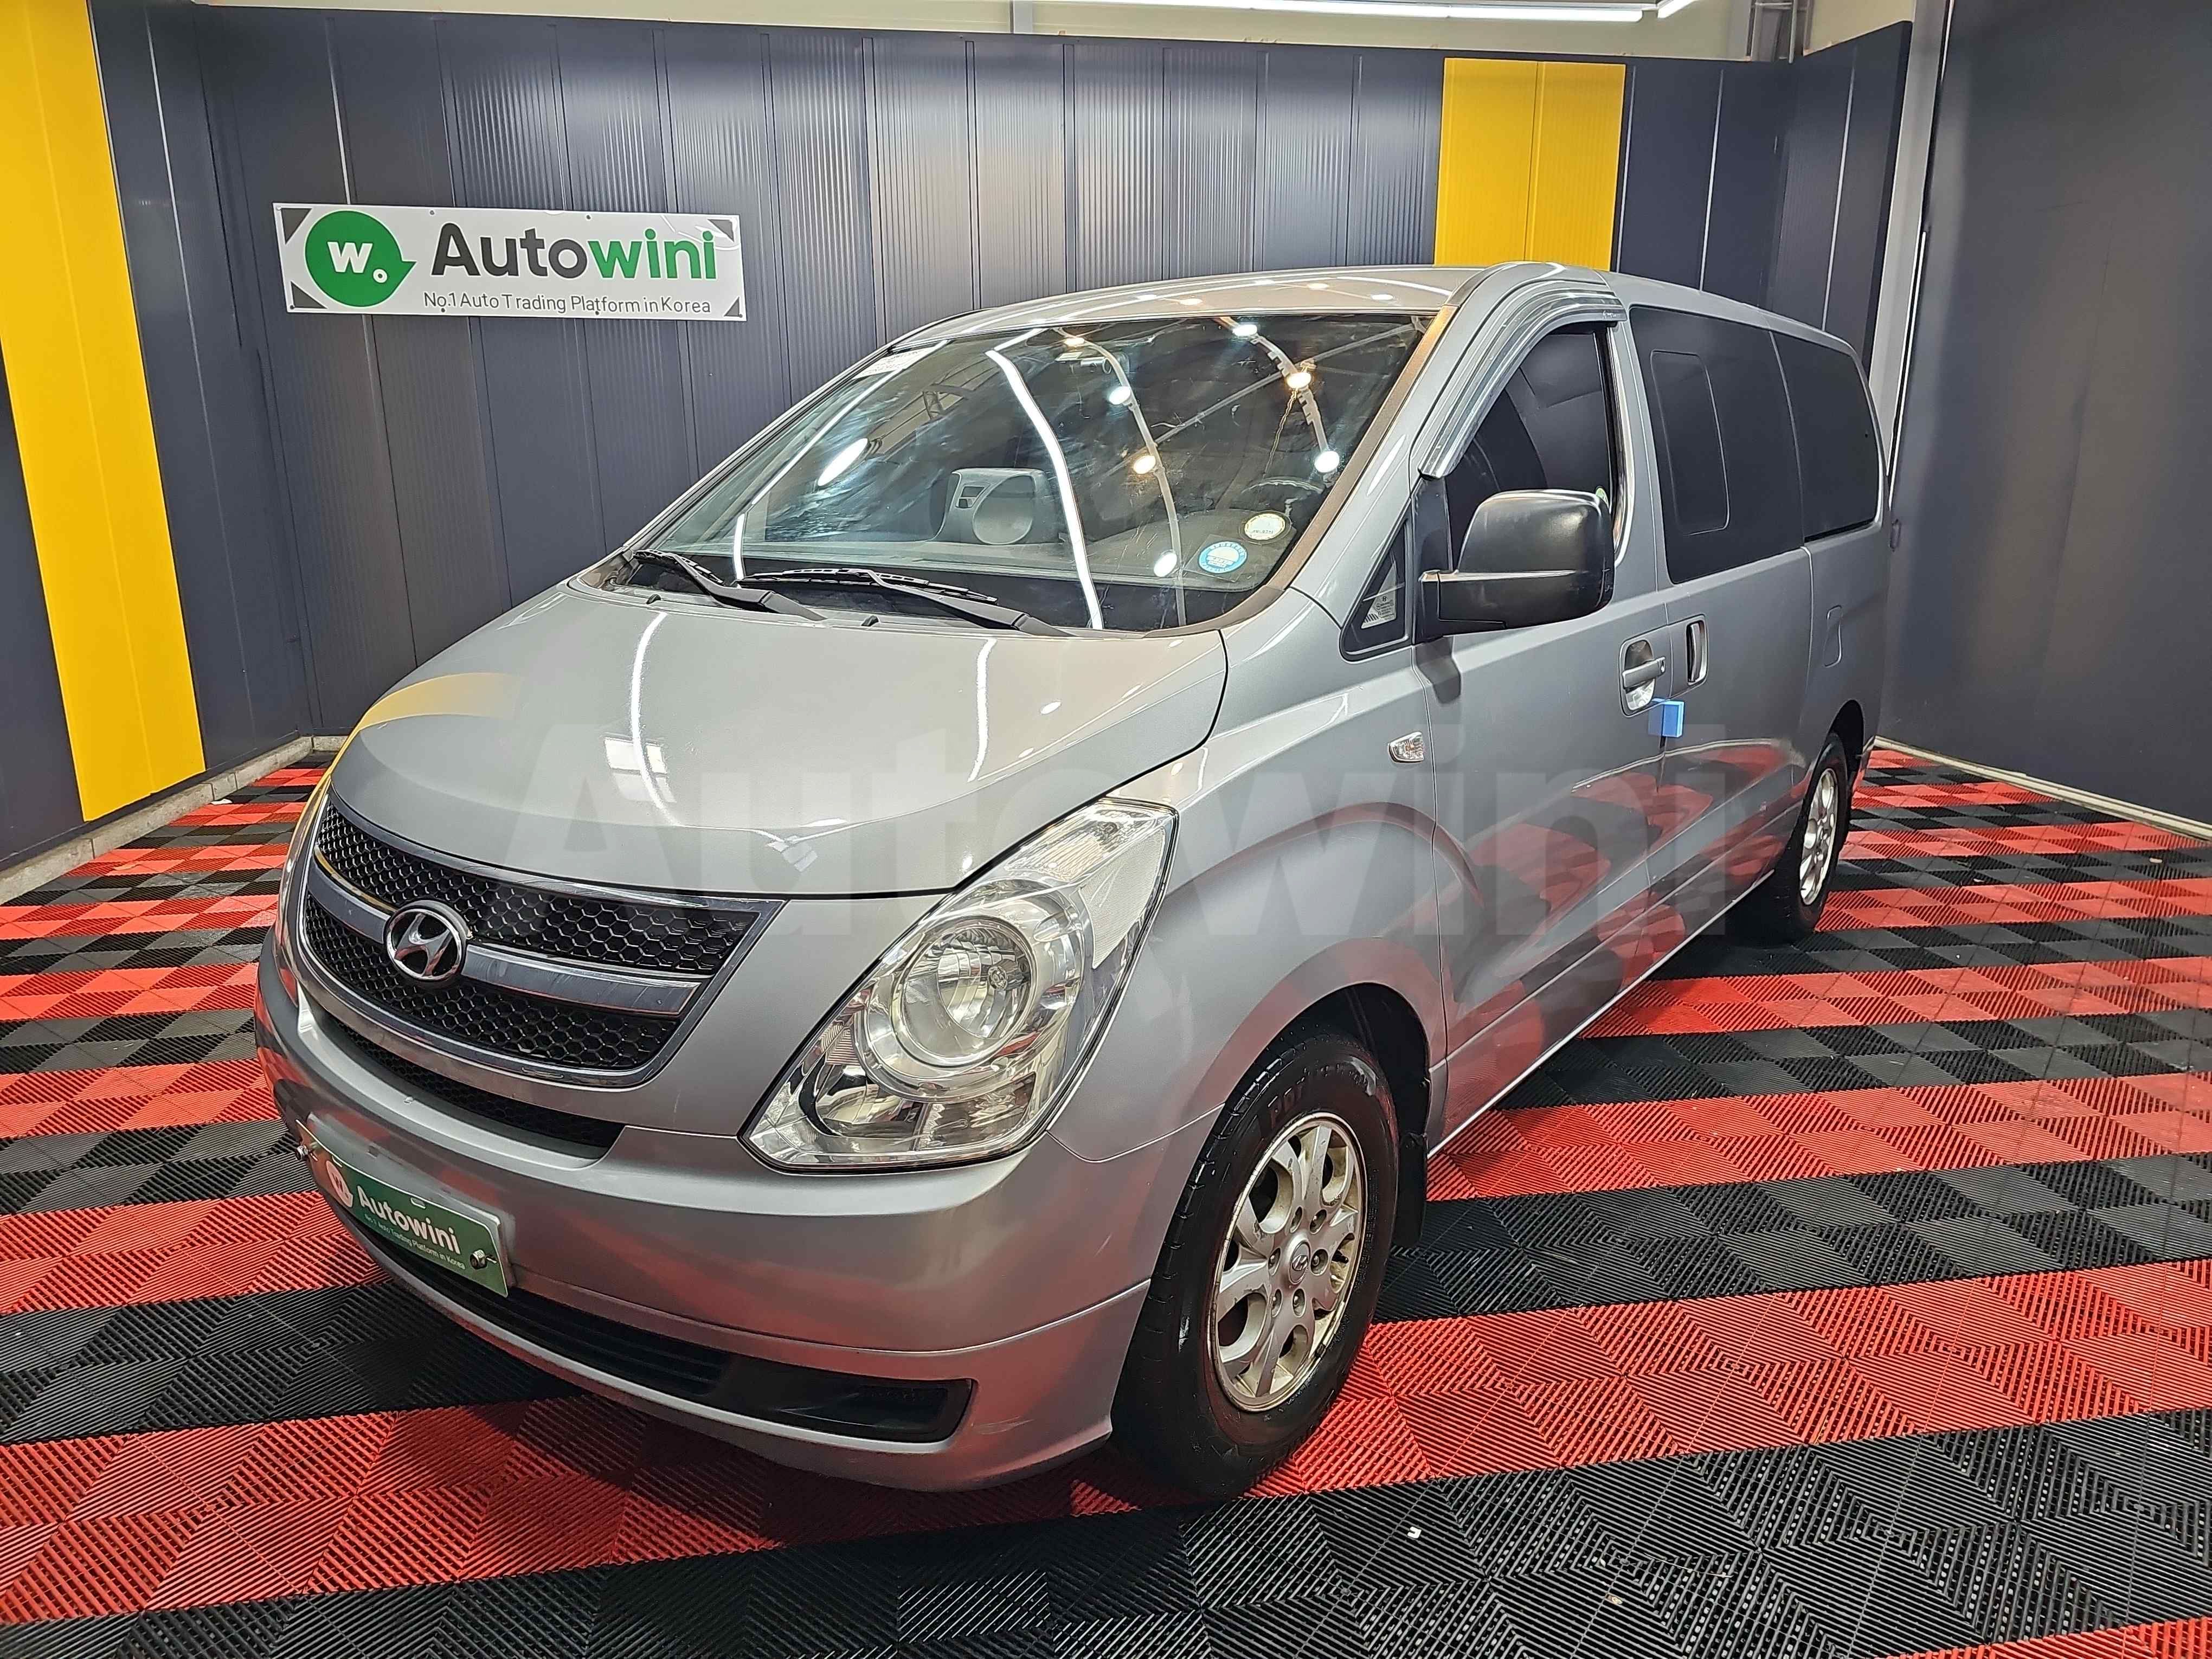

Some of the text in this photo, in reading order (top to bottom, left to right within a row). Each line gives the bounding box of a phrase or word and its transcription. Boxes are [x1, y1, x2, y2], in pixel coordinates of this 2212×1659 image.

[431, 222, 717, 279] Autowini
[423, 292, 711, 314] No.1 Auto Trading Platform in Korea
[357, 1185, 461, 1255] Autowini
